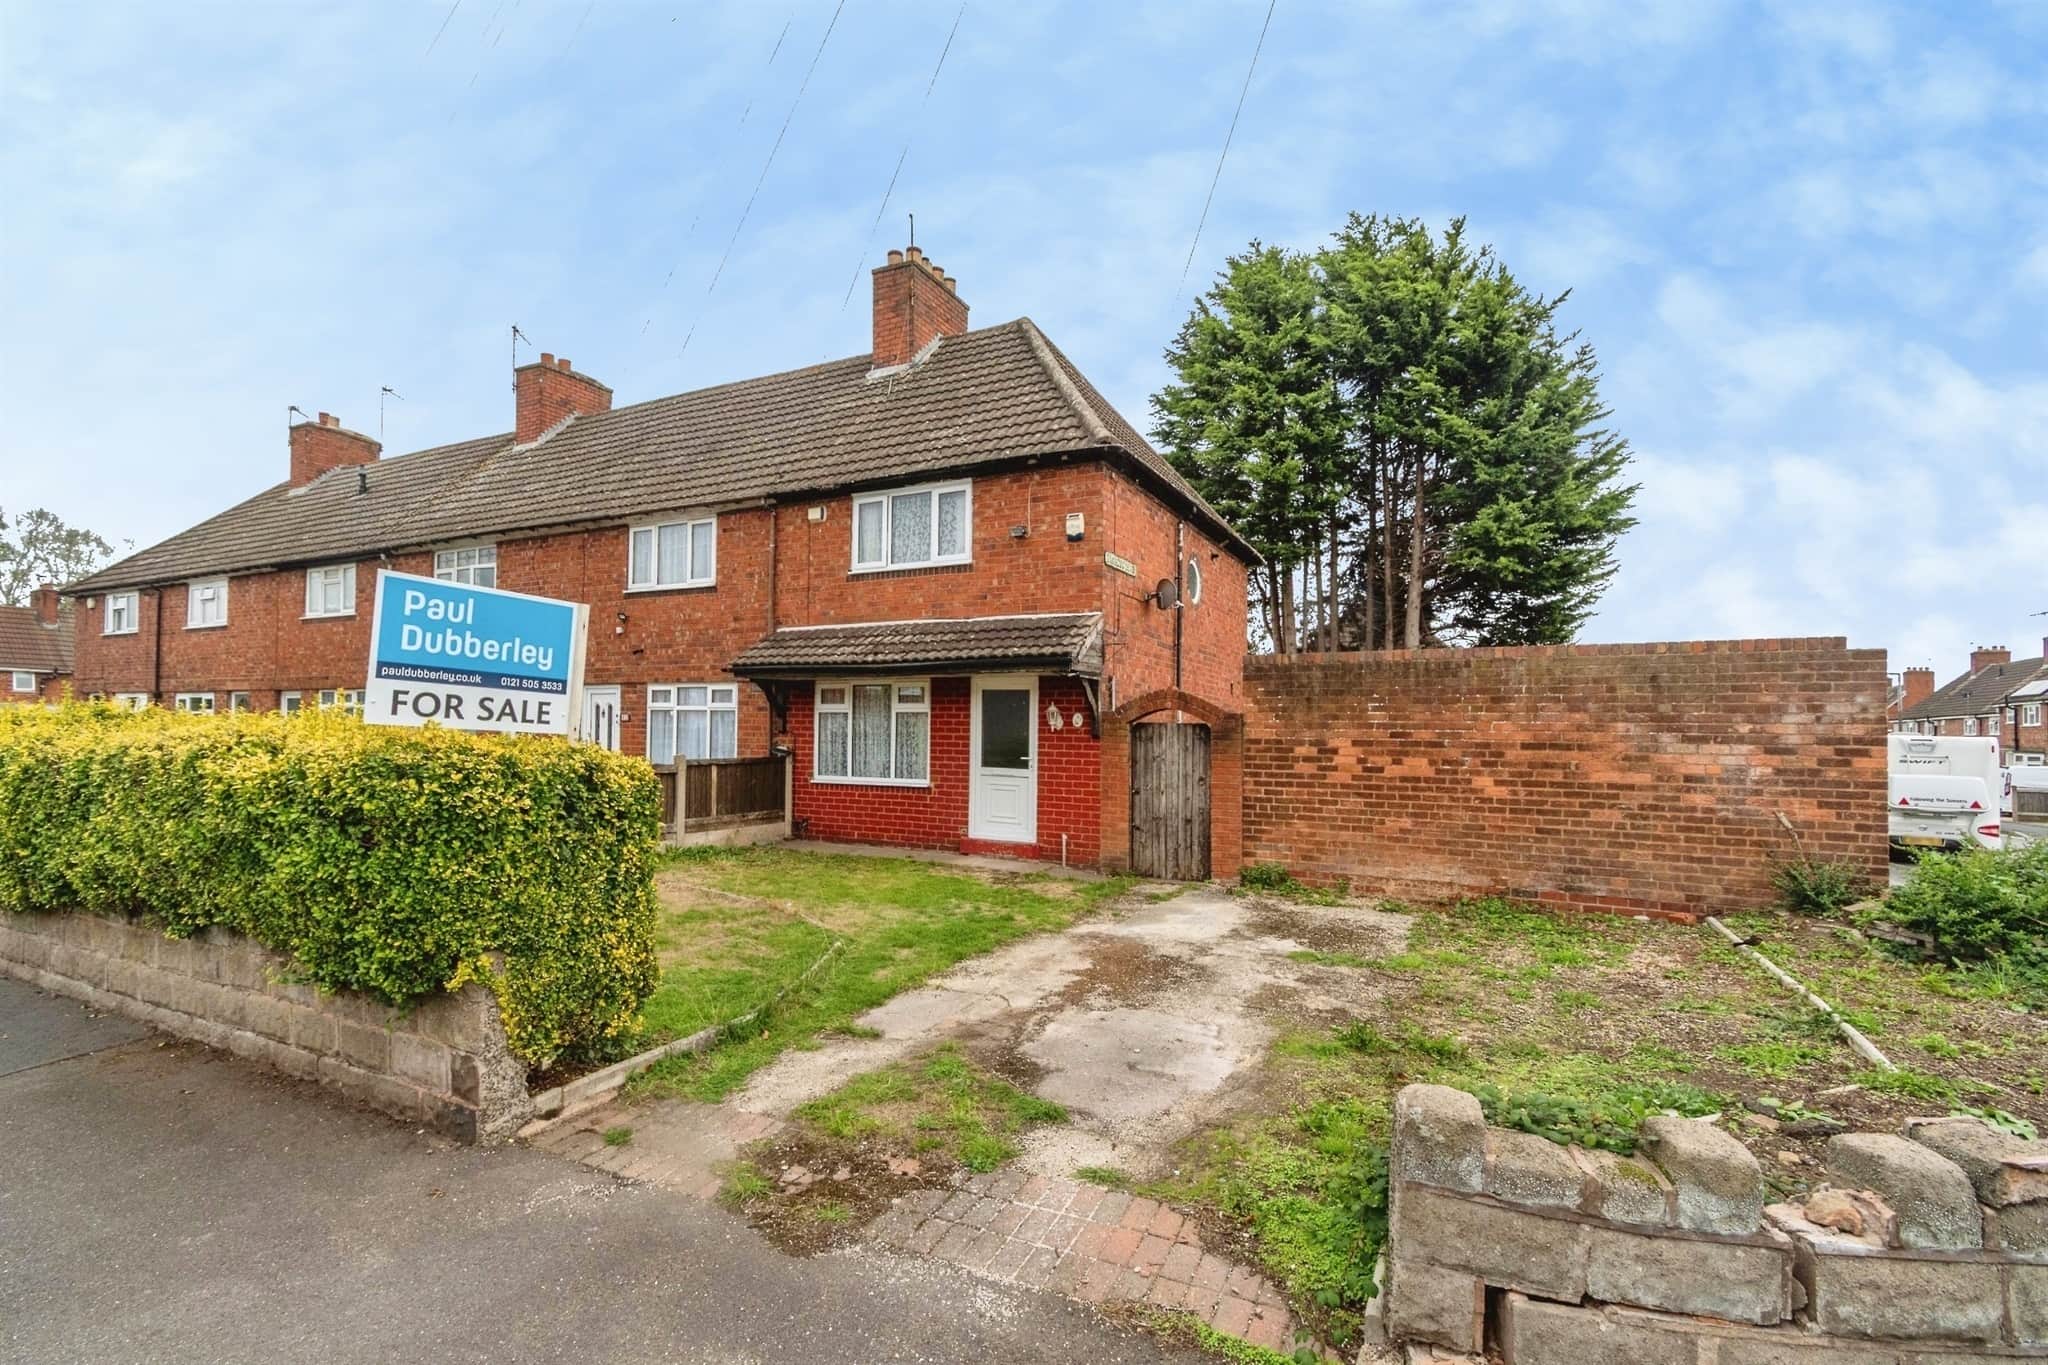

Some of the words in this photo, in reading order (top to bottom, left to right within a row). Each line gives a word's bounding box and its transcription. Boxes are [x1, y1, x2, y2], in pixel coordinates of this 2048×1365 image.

[403, 590, 475, 625] Paul
[400, 624, 553, 671] Dubberley
[381, 667, 482, 684] pauldubberley.co.uk
[501, 677, 520, 688] 0121
[522, 679, 539, 689] 505
[541, 680, 563, 691] 3533
[391, 689, 465, 720] FOR
[476, 697, 552, 725] SALE
